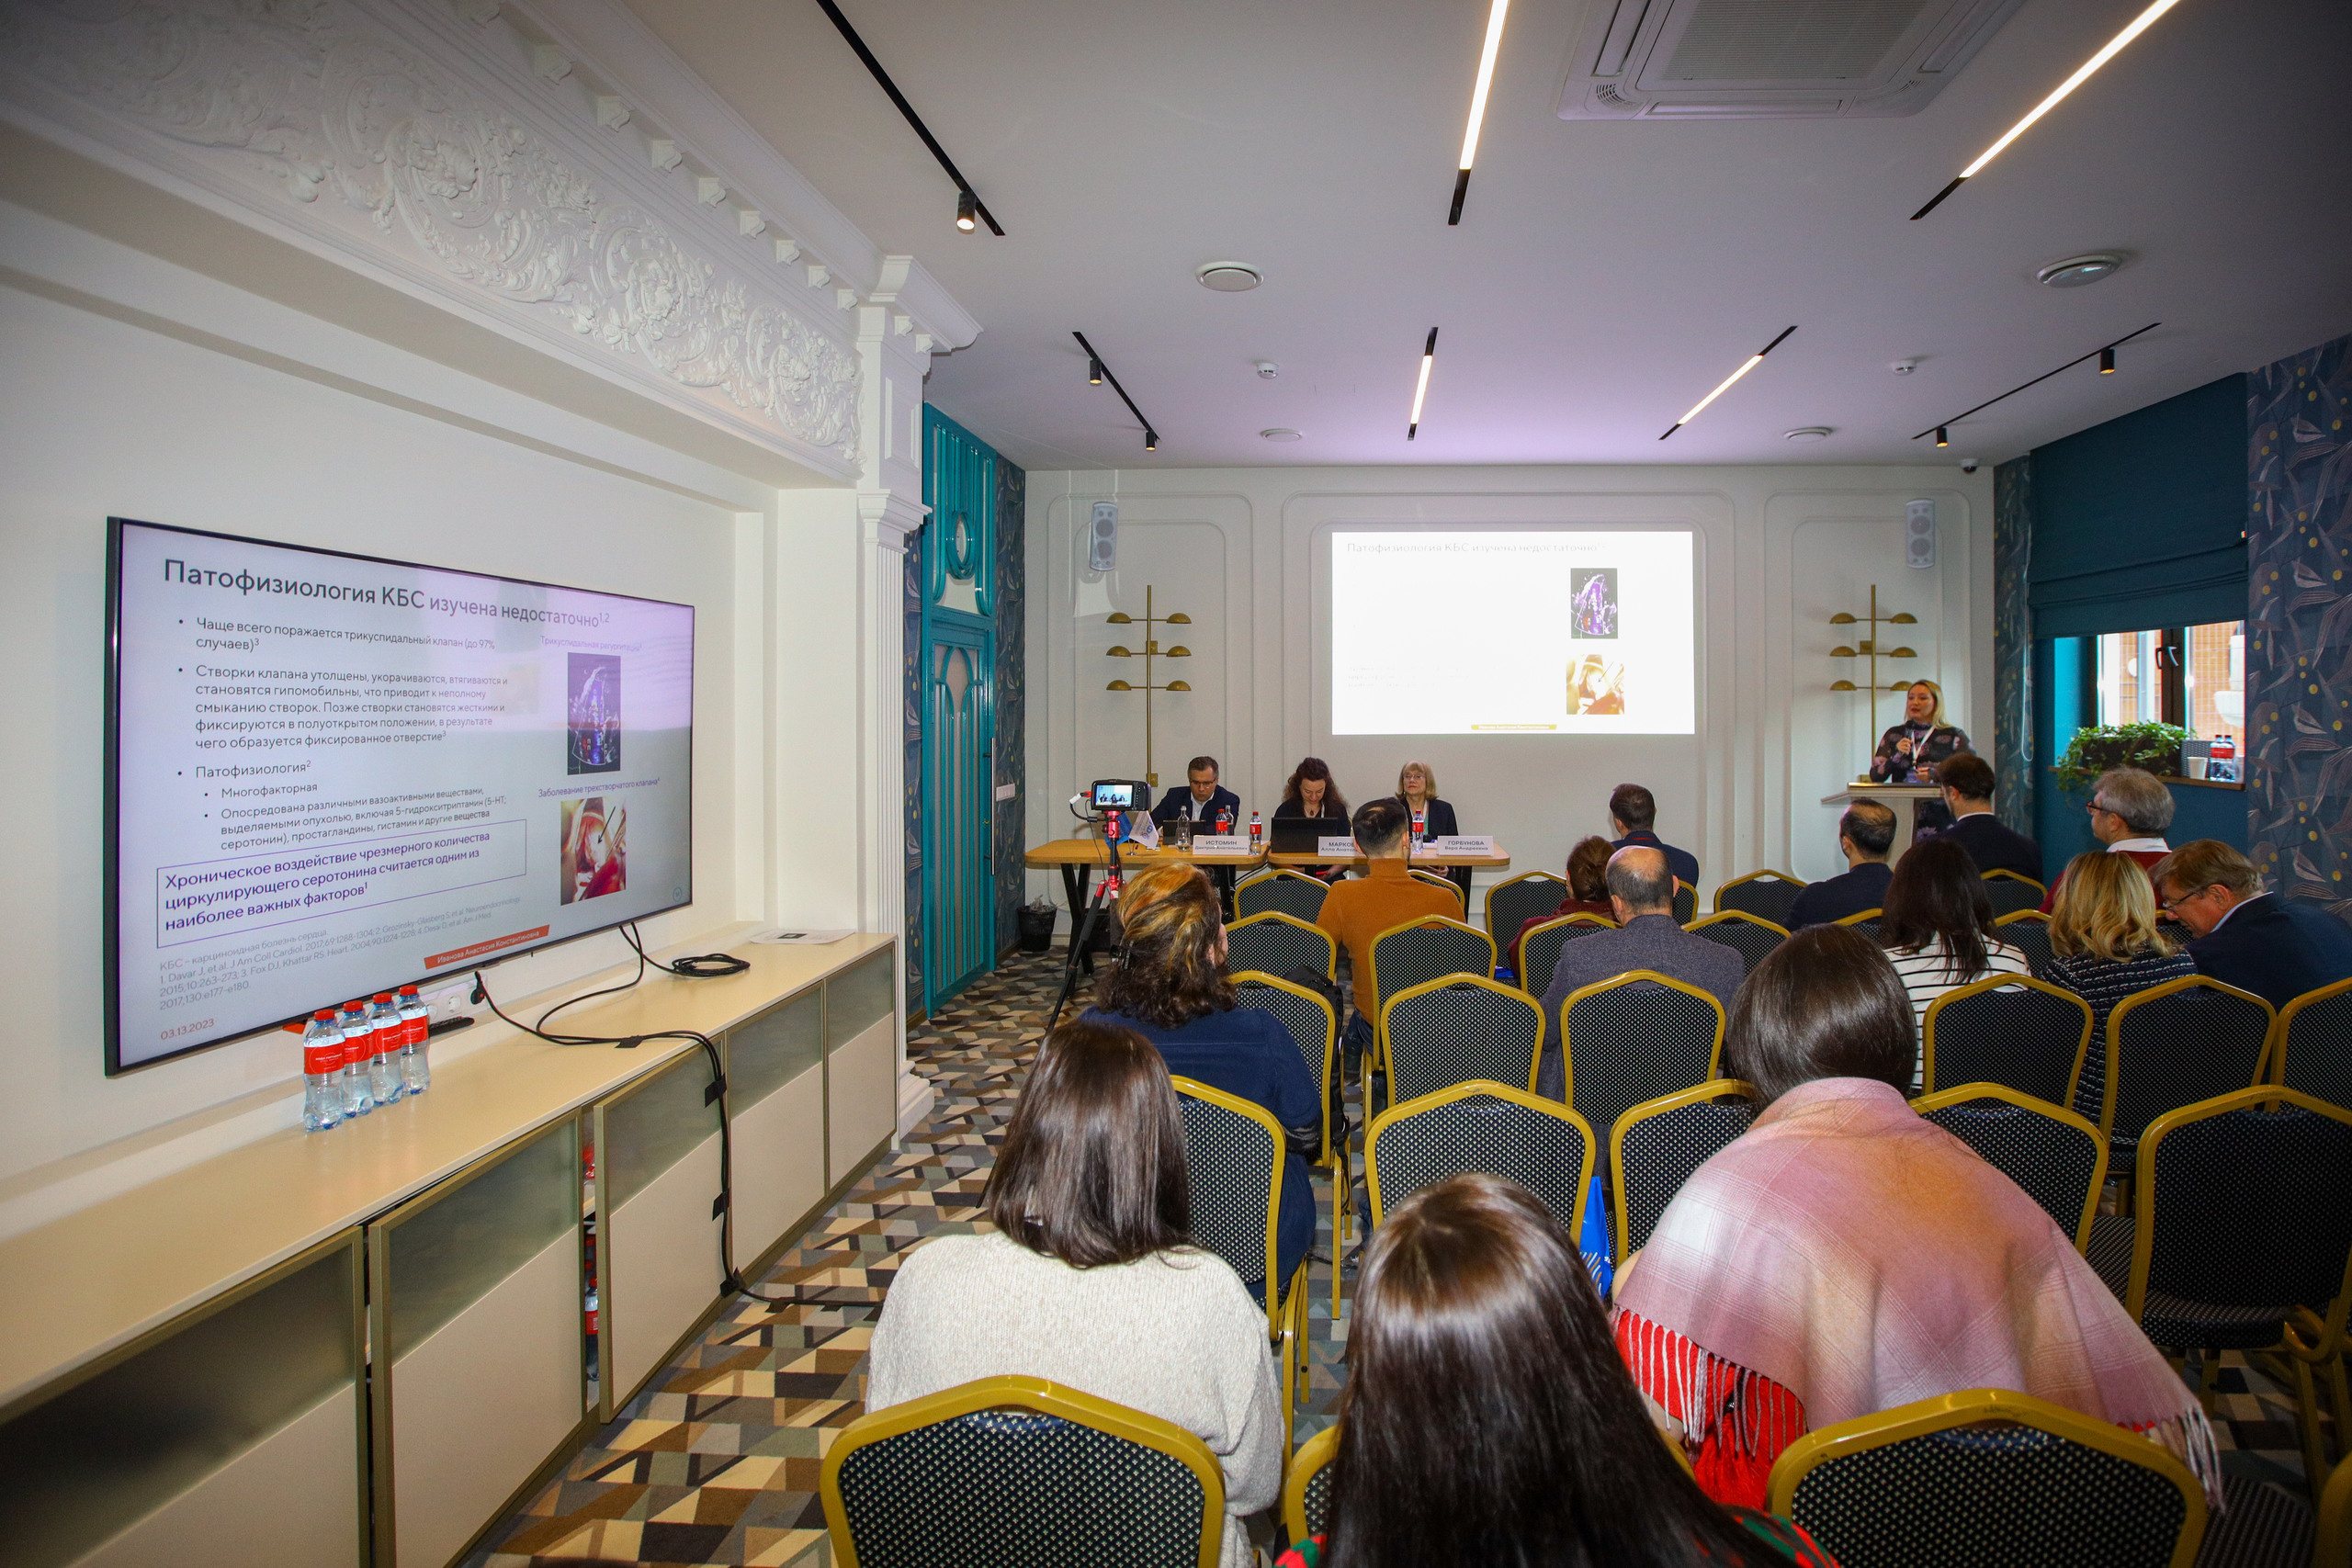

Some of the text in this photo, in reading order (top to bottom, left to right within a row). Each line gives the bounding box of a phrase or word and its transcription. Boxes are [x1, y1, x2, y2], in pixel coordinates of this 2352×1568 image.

[1347, 543, 1442, 554] Патофизиология
[1444, 543, 1470, 552] КБС
[1473, 545, 1516, 554] изучена
[164, 558, 375, 604] Патофизиология
[381, 586, 424, 608] КБС
[429, 597, 497, 620] изучена
[196, 616, 494, 649] Чаще всего поражается трикуспидальный клапан (до 97%
[195, 664, 254, 680] Створки
[257, 670, 308, 679] клапана
[310, 671, 369, 682] утолщены,
[370, 673, 447, 684] укорачиваются,
[448, 676, 501, 684] втягиваются
[195, 685, 270, 694] становятся
[273, 684, 361, 697] гипомобильны,
[383, 689, 429, 699] приводит
[438, 690, 486, 699] неполному
[195, 704, 266, 712] смыканию
[268, 704, 321, 715] створок.
[322, 701, 359, 712] Позже
[360, 704, 402, 715] створки
[195, 717, 285, 733] фиксируются
[288, 720, 295, 728] в
[297, 719, 378, 731] полуоткрытом
[379, 718, 436, 728] положении,
[446, 718, 492, 728] результате
[195, 739, 227, 749] чего
[229, 735, 301, 750] образуется
[304, 732, 391, 747] фиксированное
[220, 781, 317, 801] Многофакторная
[220, 787, 483, 821] Опосредована различными вазоактивными веществами,
[220, 818, 300, 836] выделяемыми
[301, 813, 353, 829] опухолью,
[355, 809, 393, 819] включая
[395, 797, 483, 817] 5-гидрокситриптамин
[220, 832, 288, 852] серотонин),
[291, 824, 375, 843] простагландины,
[377, 819, 417, 830] гистамин
[424, 815, 452, 826] другие
[453, 810, 490, 821] вещества
[164, 832, 490, 892] Хроническое воздействие чрезмерного количества
[164, 849, 480, 914] циркулирующего серотонина считается одним из
[165, 904, 243, 931] наиболее
[247, 897, 300, 915] важных
[167, 967, 196, 982] Davar
[236, 955, 253, 966] Am
[253, 951, 271, 963] Coll
[250, 964, 266, 976] Fox
[160, 1017, 214, 1040] 03.13.2023
